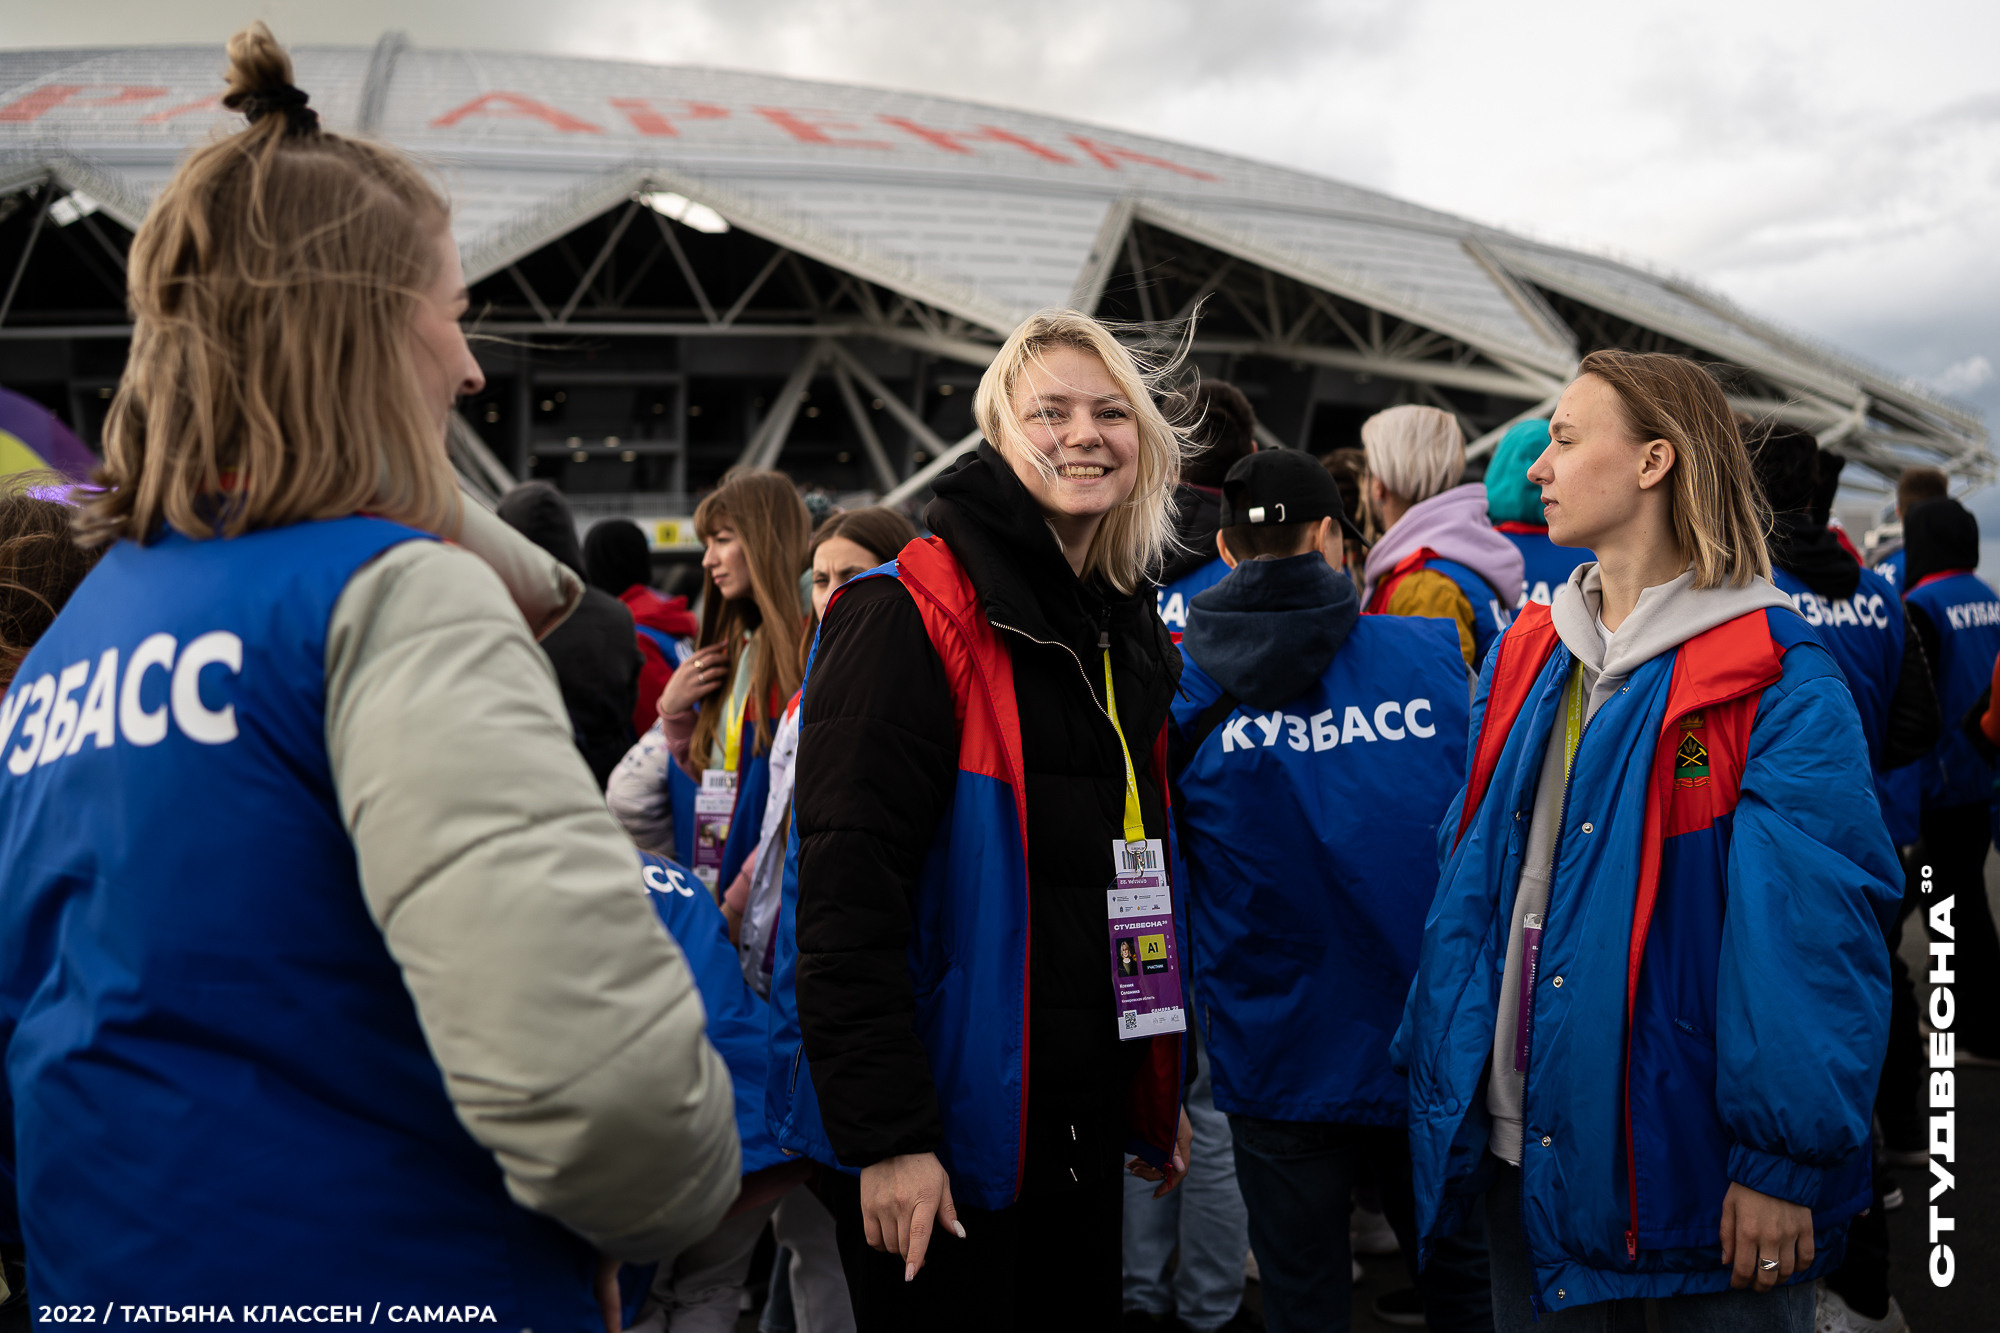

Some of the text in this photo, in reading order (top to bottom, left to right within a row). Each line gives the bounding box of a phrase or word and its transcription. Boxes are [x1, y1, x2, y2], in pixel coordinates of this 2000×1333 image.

[430, 90, 1222, 183] АРЕНА
[1220, 698, 1436, 754] КУЗБАСС
[1113, 920, 1163, 931] СТУДВЕСНА
[1147, 942, 1159, 954] А1
